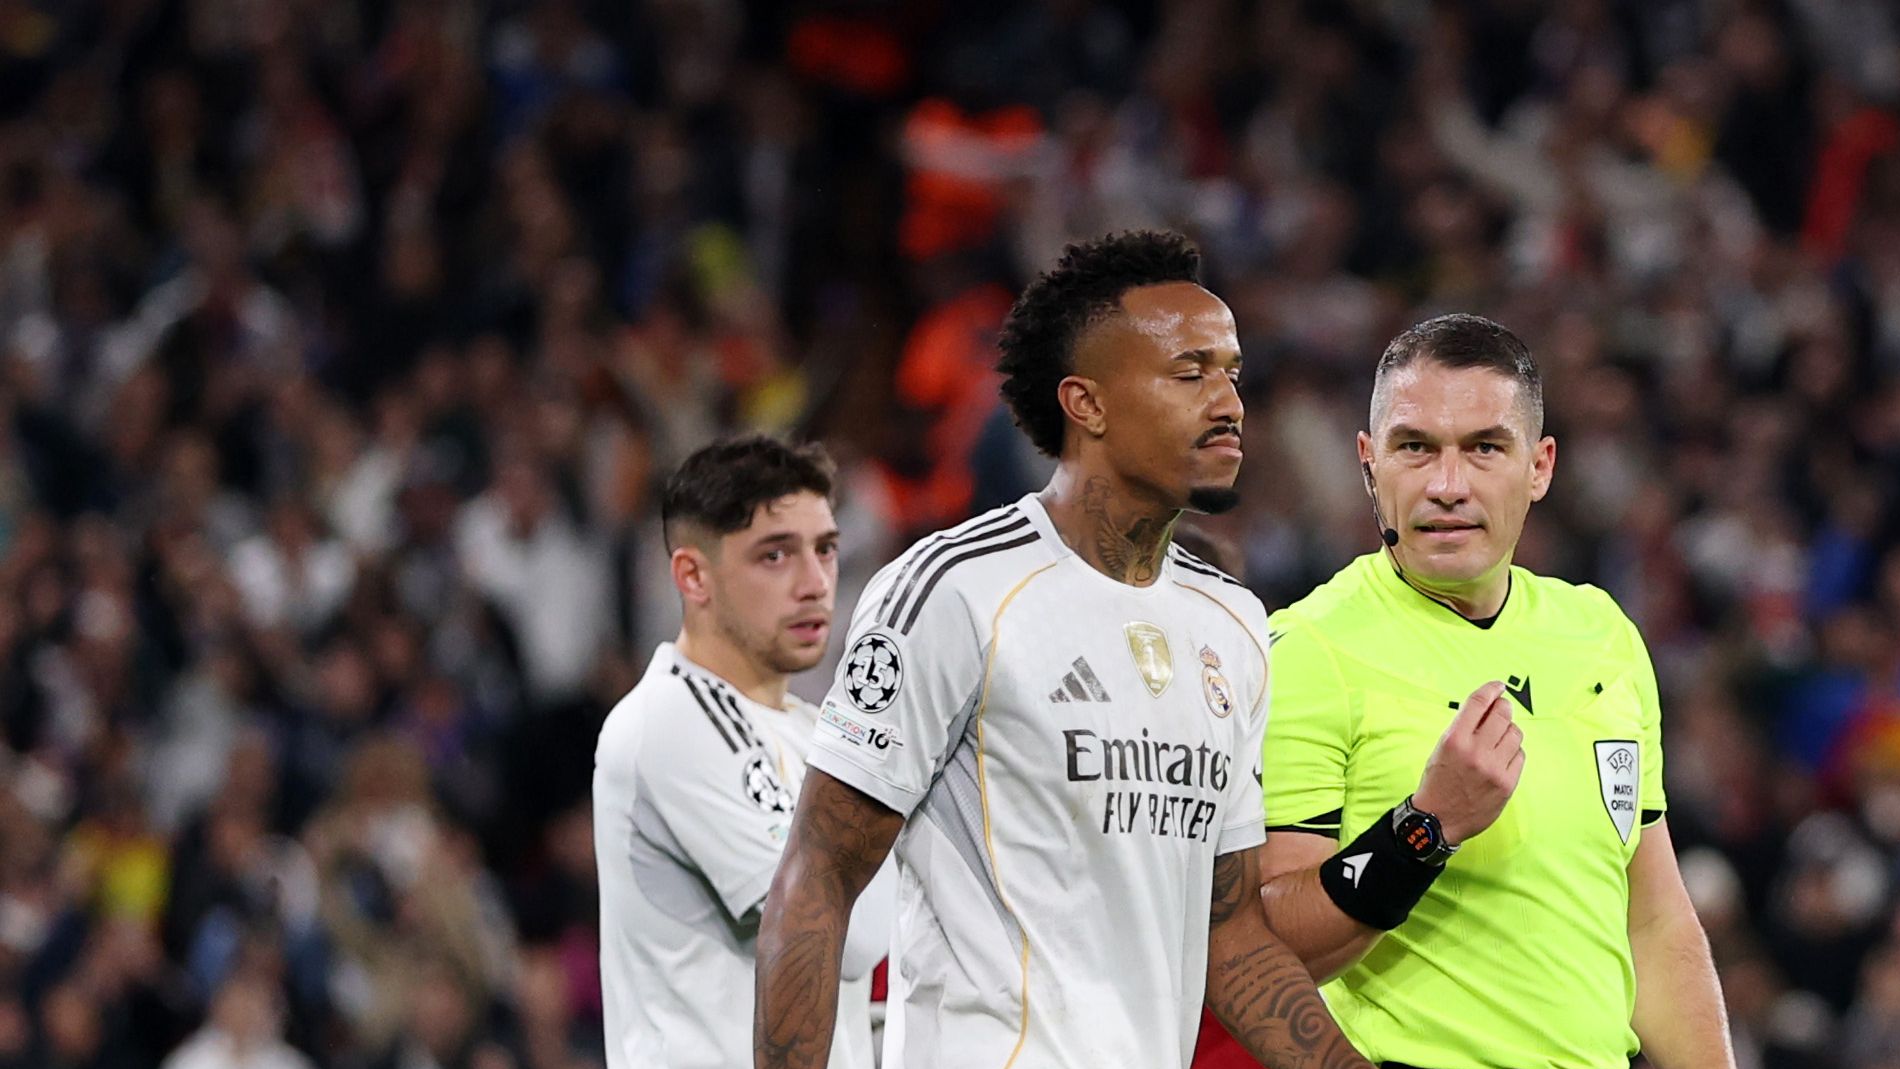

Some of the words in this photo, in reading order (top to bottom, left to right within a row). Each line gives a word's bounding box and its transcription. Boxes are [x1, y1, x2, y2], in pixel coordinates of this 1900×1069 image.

[1062, 727, 1232, 793] Emirates
[1610, 752, 1634, 771] UEFA
[1613, 784, 1633, 796] MATCH
[1611, 800, 1634, 812] OFFICIAL
[1102, 791, 1142, 834] FLY
[1149, 793, 1216, 843] BETTER
